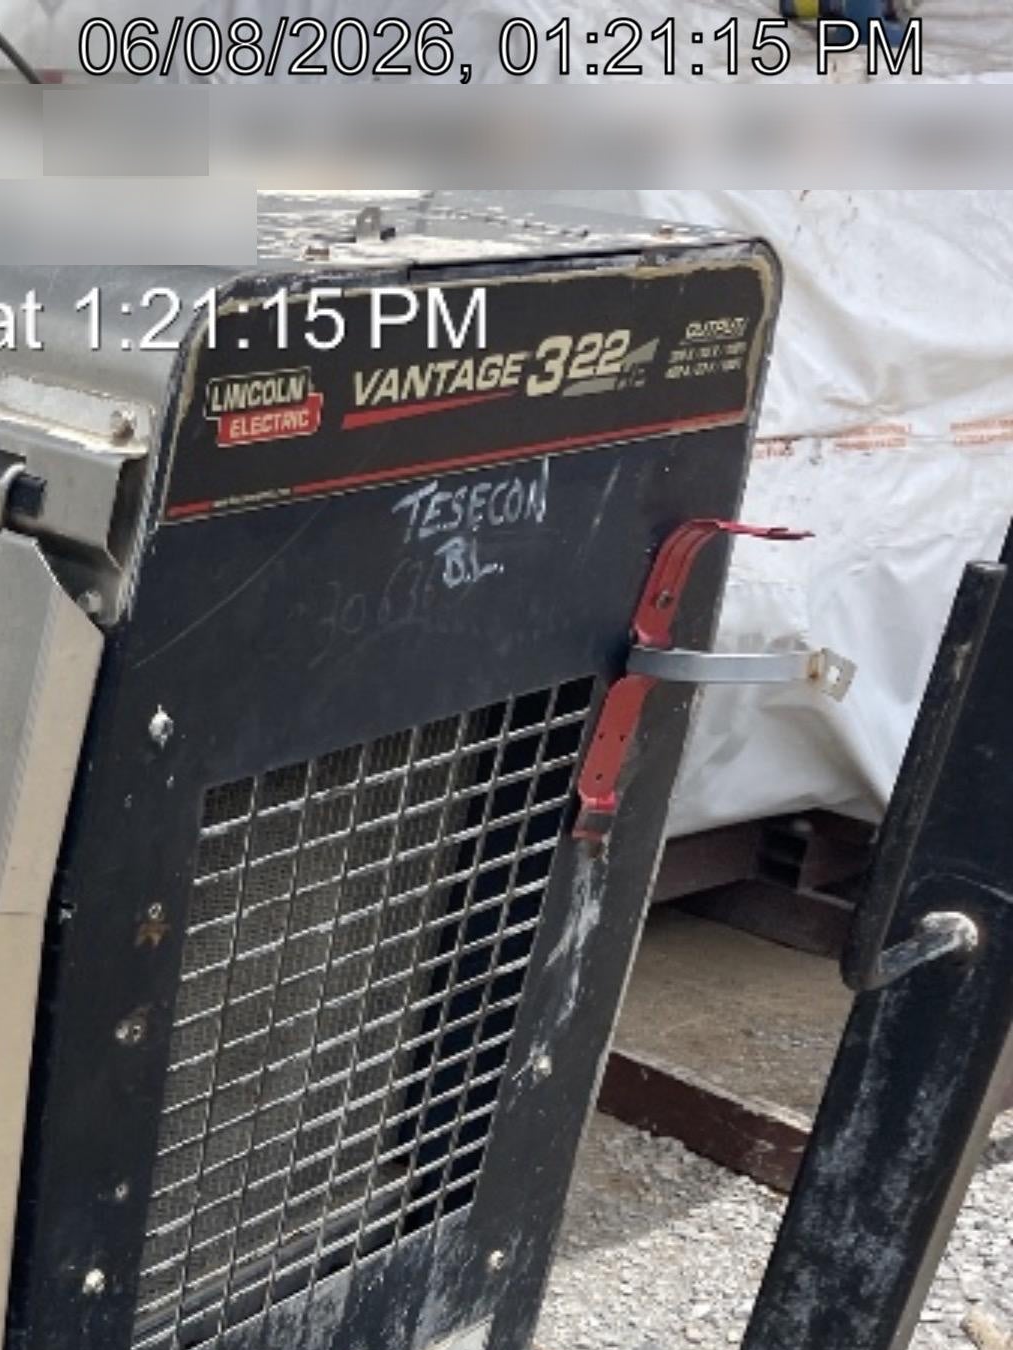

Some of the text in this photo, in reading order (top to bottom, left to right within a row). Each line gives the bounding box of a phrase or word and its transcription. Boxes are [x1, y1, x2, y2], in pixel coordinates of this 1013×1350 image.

[354, 328, 631, 406] VANTAGE 322
[211, 375, 306, 412] LINCOLN
[229, 411, 310, 439] ELECTRIC
